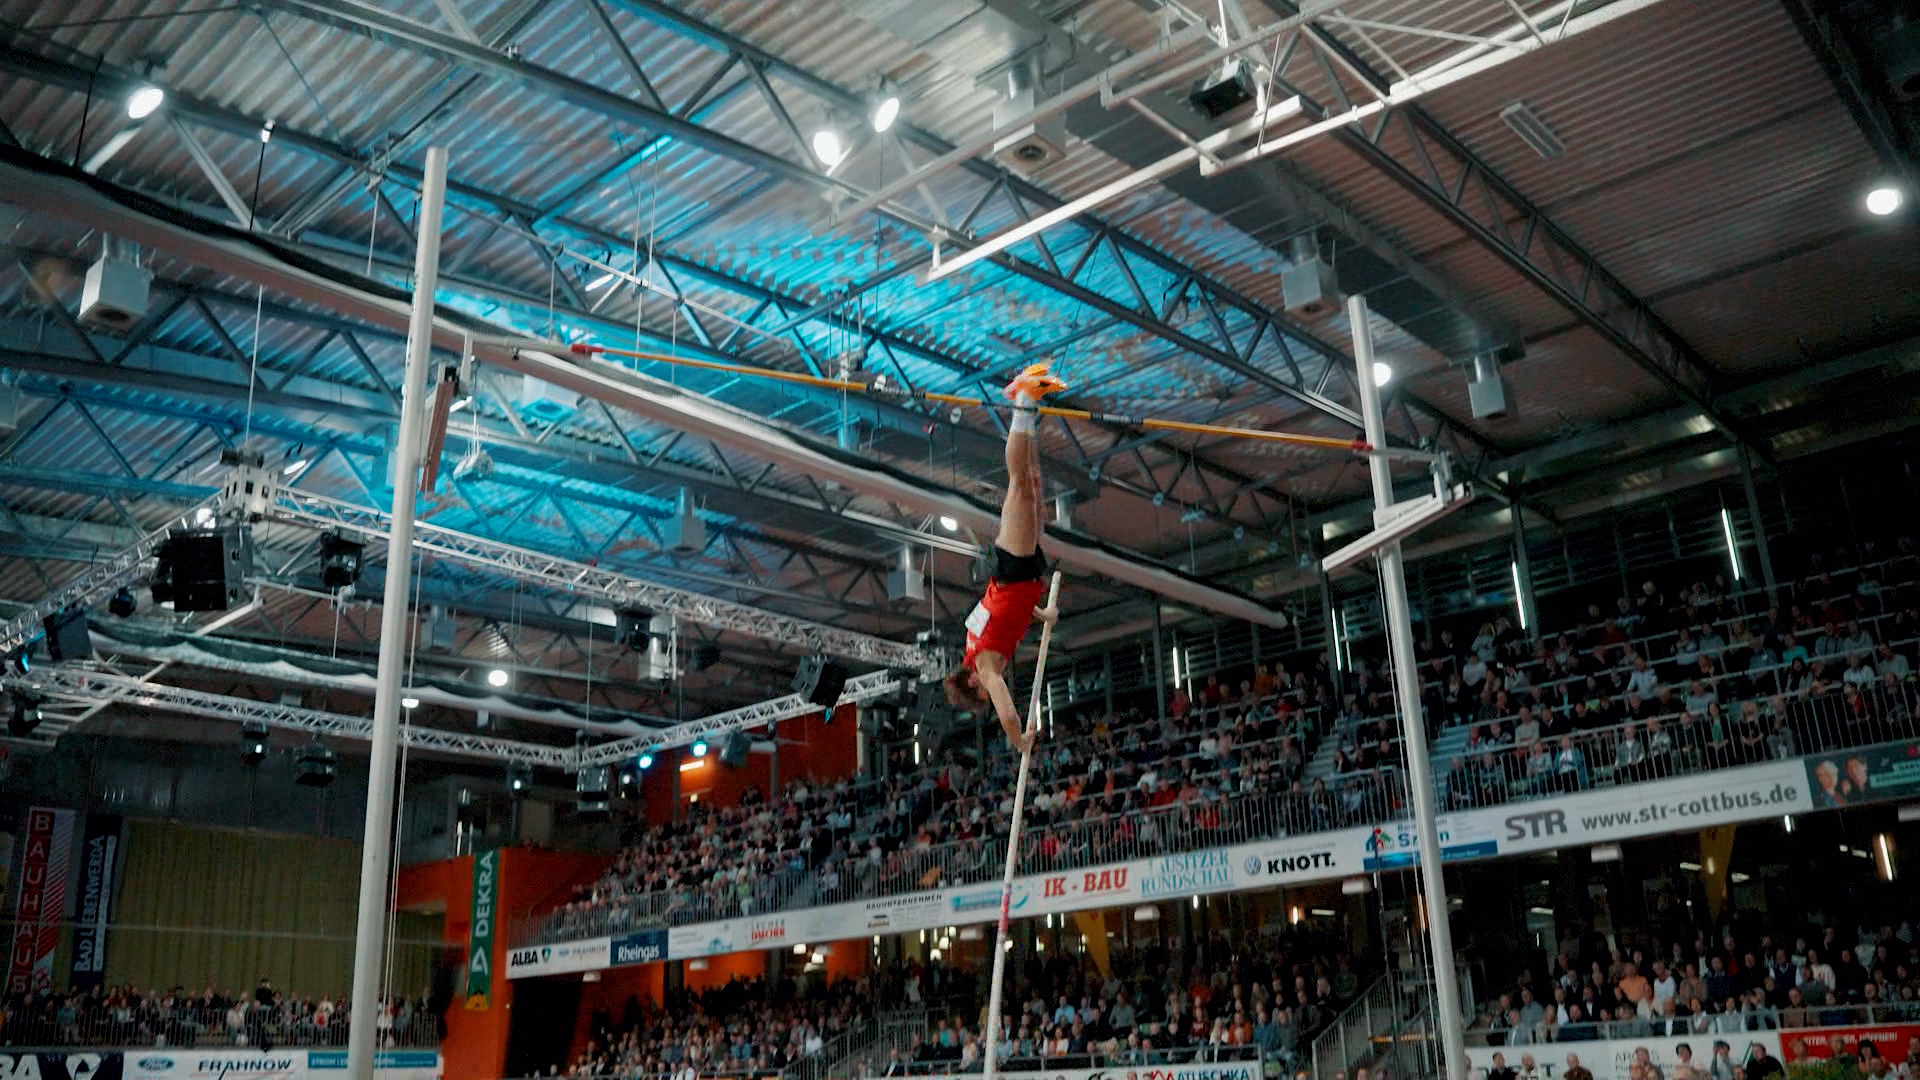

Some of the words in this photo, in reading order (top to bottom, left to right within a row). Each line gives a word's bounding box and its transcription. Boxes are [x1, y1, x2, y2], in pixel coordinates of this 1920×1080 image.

[1504, 808, 1568, 841] STR
[1581, 783, 1798, 831] www.str-cottbus.de
[1149, 849, 1230, 875] LAUSITZER
[1267, 852, 1336, 874] KNOTT.
[1043, 877, 1067, 898] IK
[1083, 867, 1128, 893] BAU
[1141, 865, 1234, 894] RUNDSCHAU
[11, 814, 50, 993] BAUHAUS
[475, 850, 494, 937] DEKRA
[866, 894, 942, 910] BAUUNTERNEHMEN
[73, 938, 94, 972] BAD
[511, 950, 539, 967] ALBA
[617, 944, 660, 962] Rheingas
[198, 1058, 292, 1072] FRAHNOW
